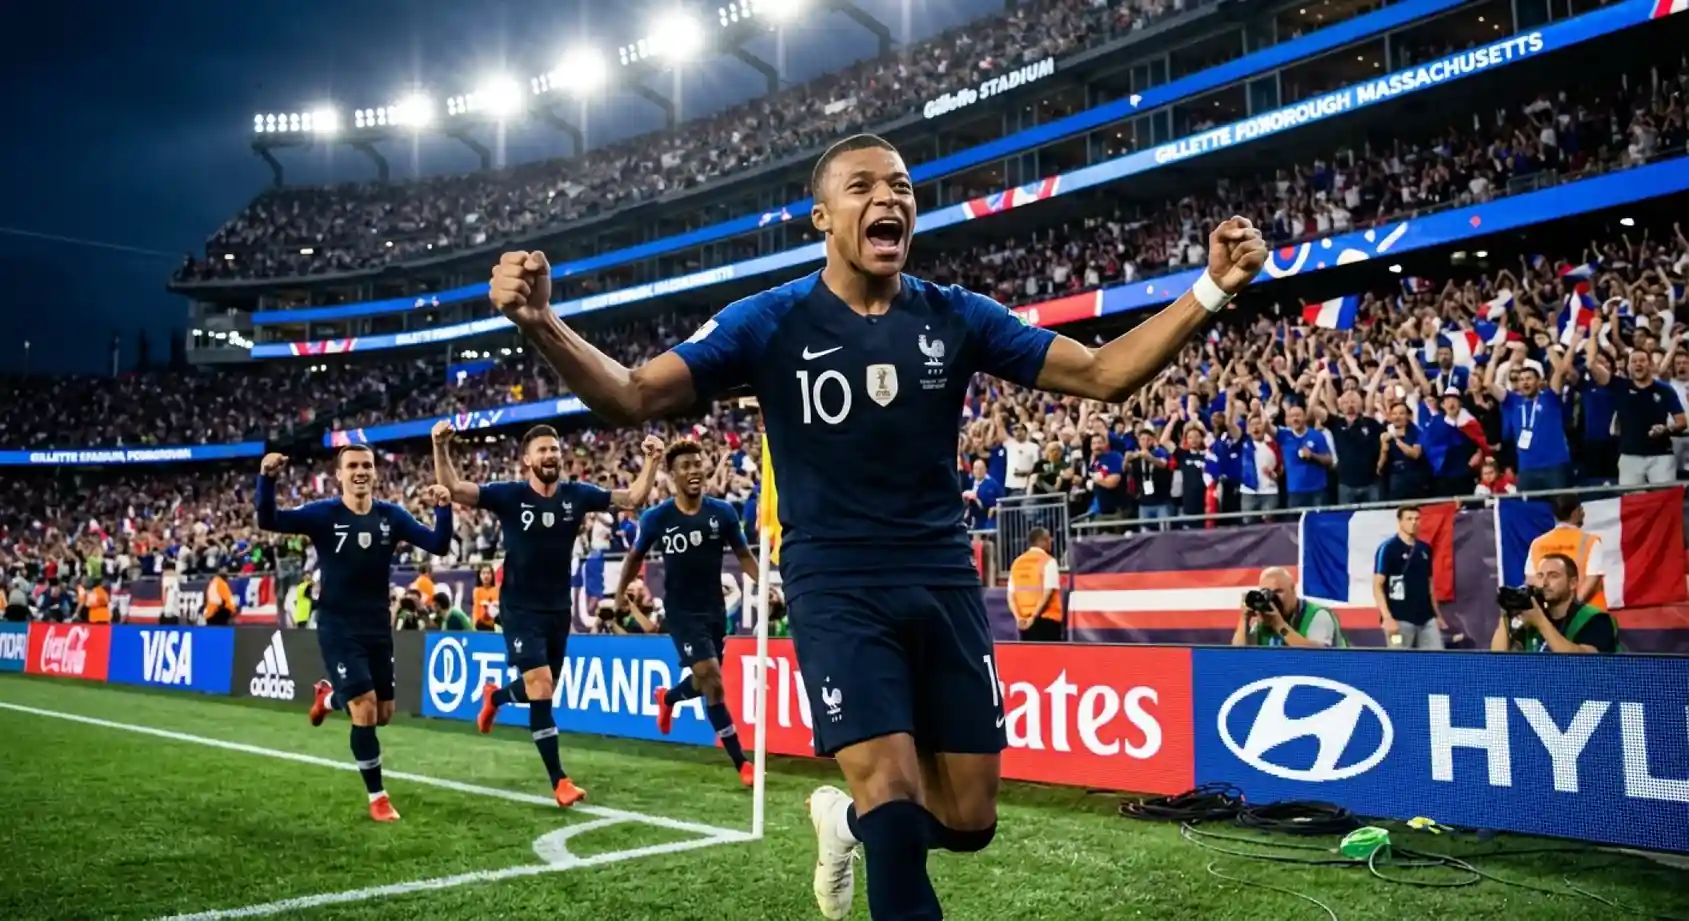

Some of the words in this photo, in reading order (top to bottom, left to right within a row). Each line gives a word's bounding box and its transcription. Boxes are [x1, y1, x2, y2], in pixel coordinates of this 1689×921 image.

[979, 57, 1054, 99] STADIUM
[1156, 126, 1231, 163] GILLETTE
[1356, 32, 1543, 105] MASSACHUSETTS
[797, 369, 852, 424] 10
[335, 532, 348, 553] 7
[521, 510, 534, 531] 9
[662, 533, 688, 554] 20
[140, 630, 192, 686] VISA
[552, 656, 705, 720] WANDA
[998, 668, 1162, 760] ates
